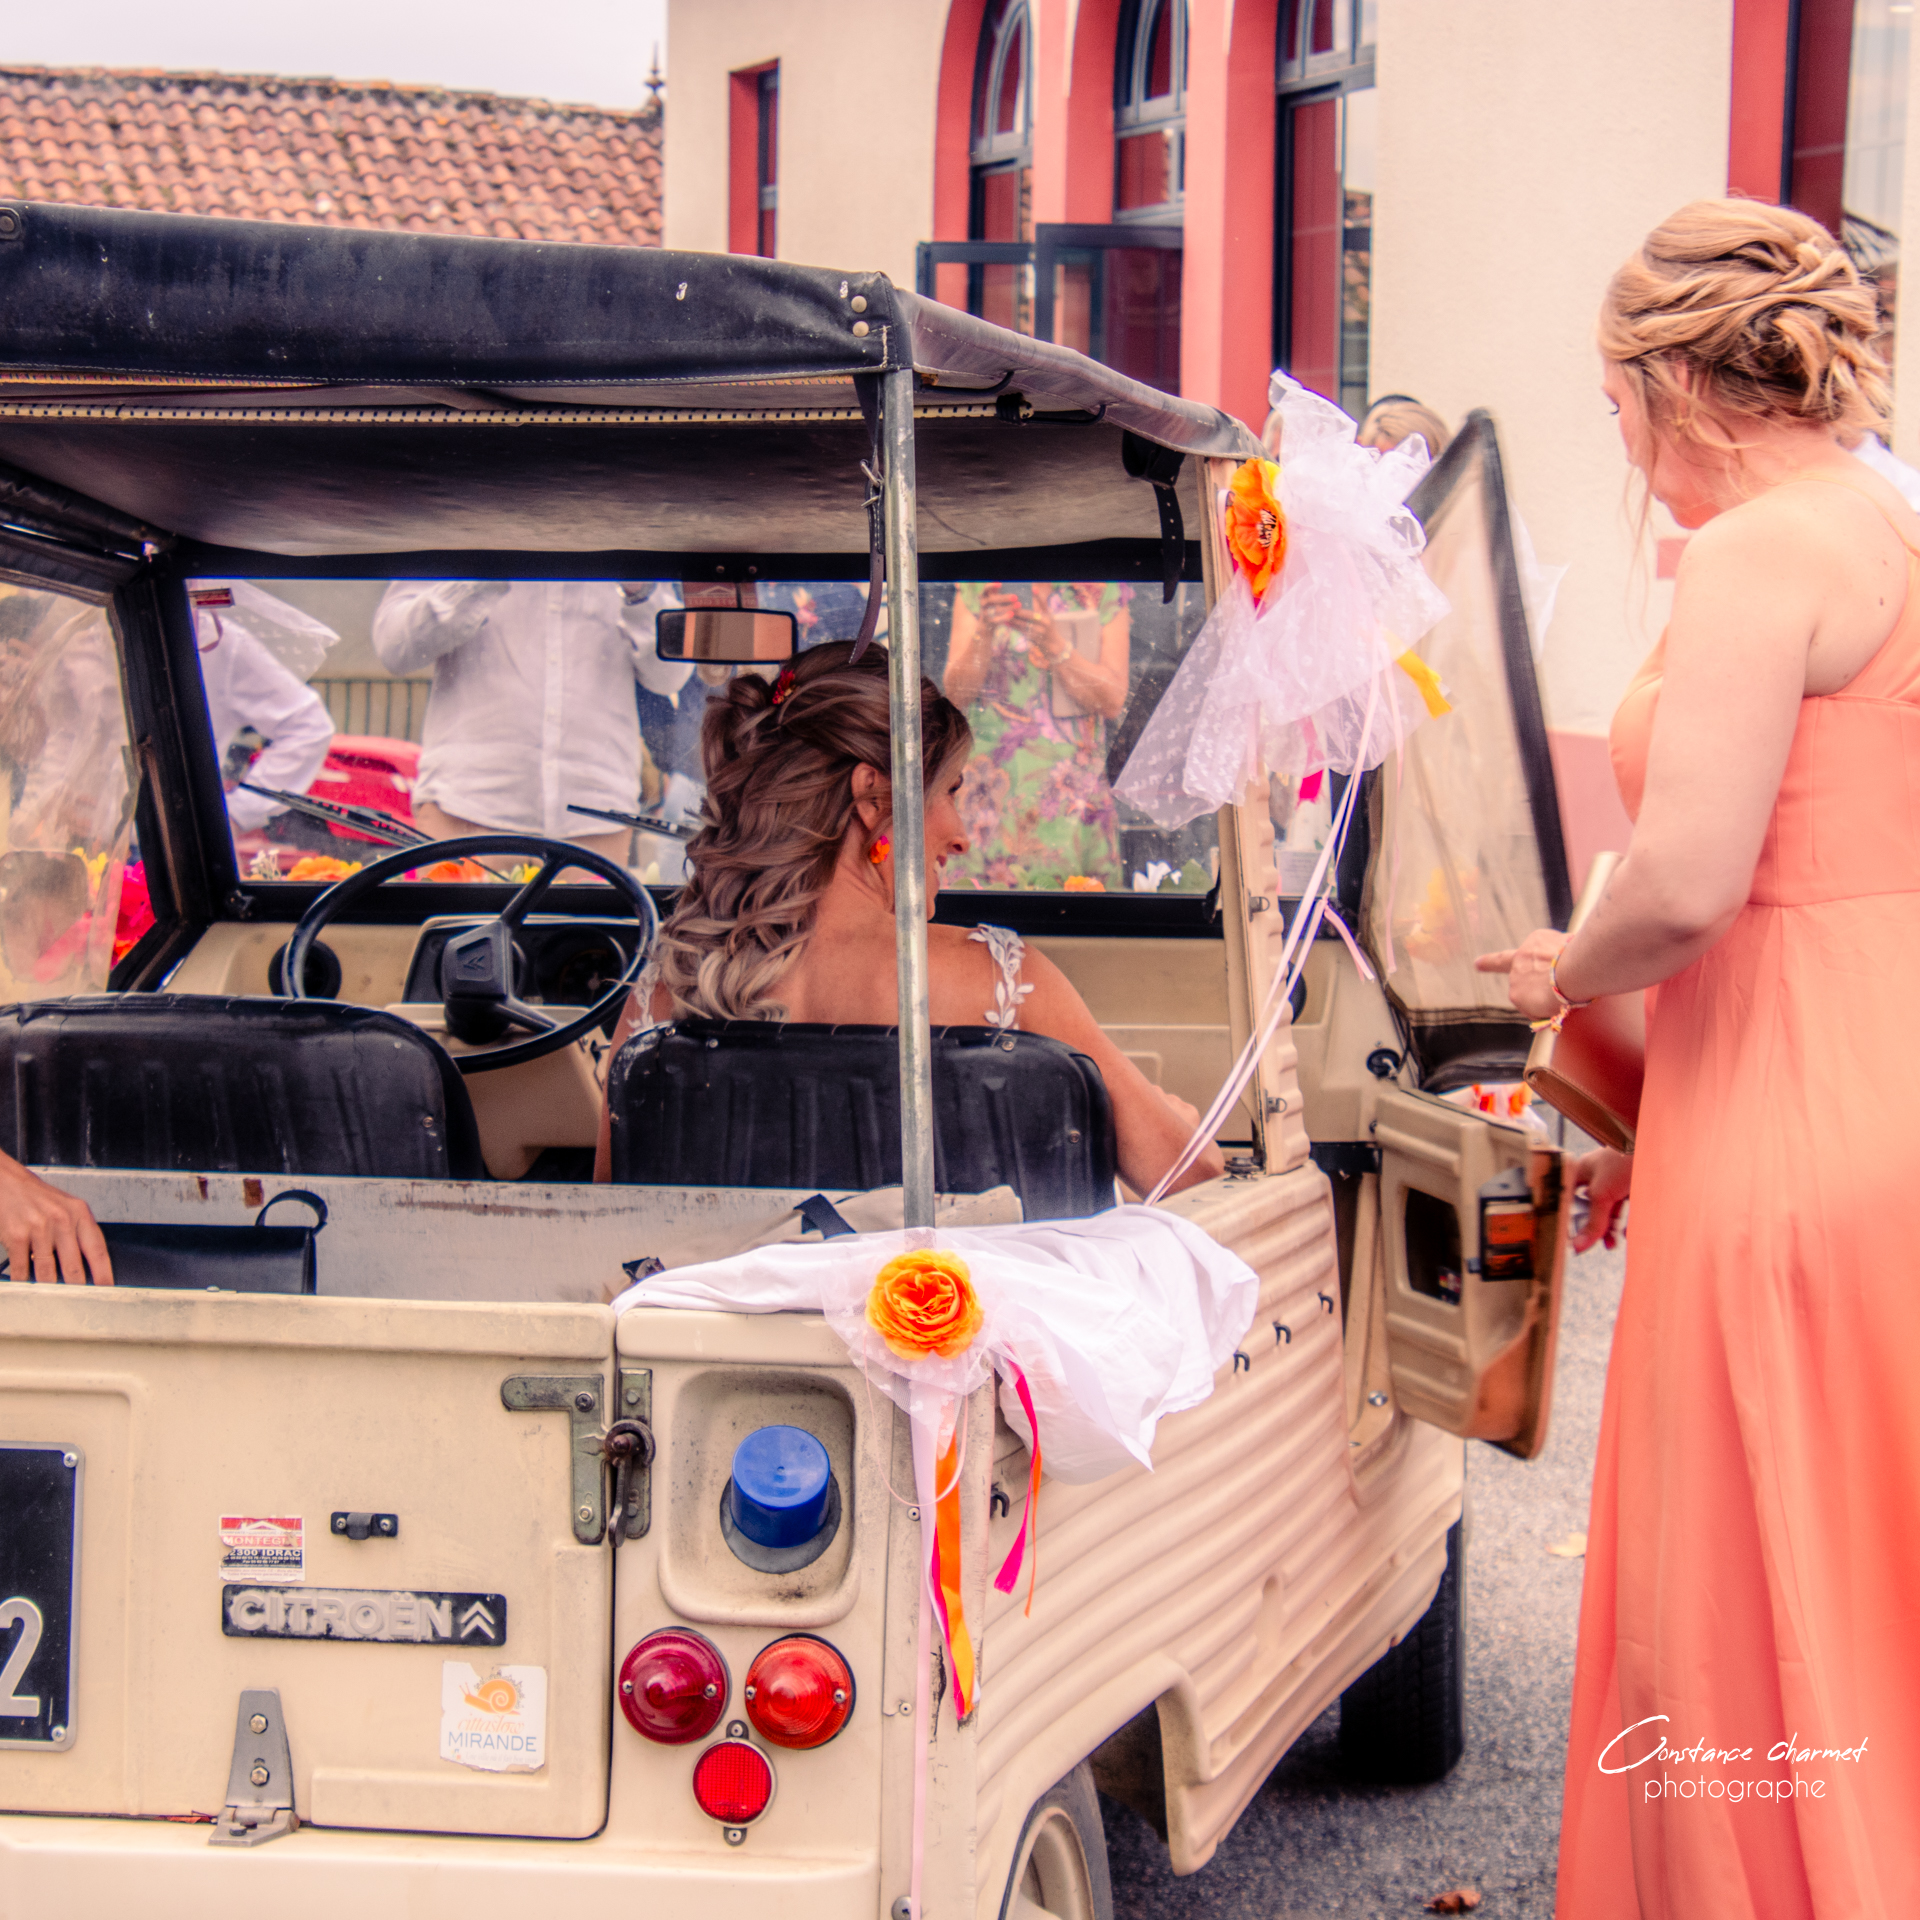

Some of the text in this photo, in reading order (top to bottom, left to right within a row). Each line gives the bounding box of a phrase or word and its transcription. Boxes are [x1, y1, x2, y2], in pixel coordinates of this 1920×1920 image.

[223, 1536, 301, 1545] MONTEG
[262, 1549, 301, 1557] IDRAC
[232, 1592, 452, 1639] CITROËN
[448, 1731, 537, 1752] MIRANDE
